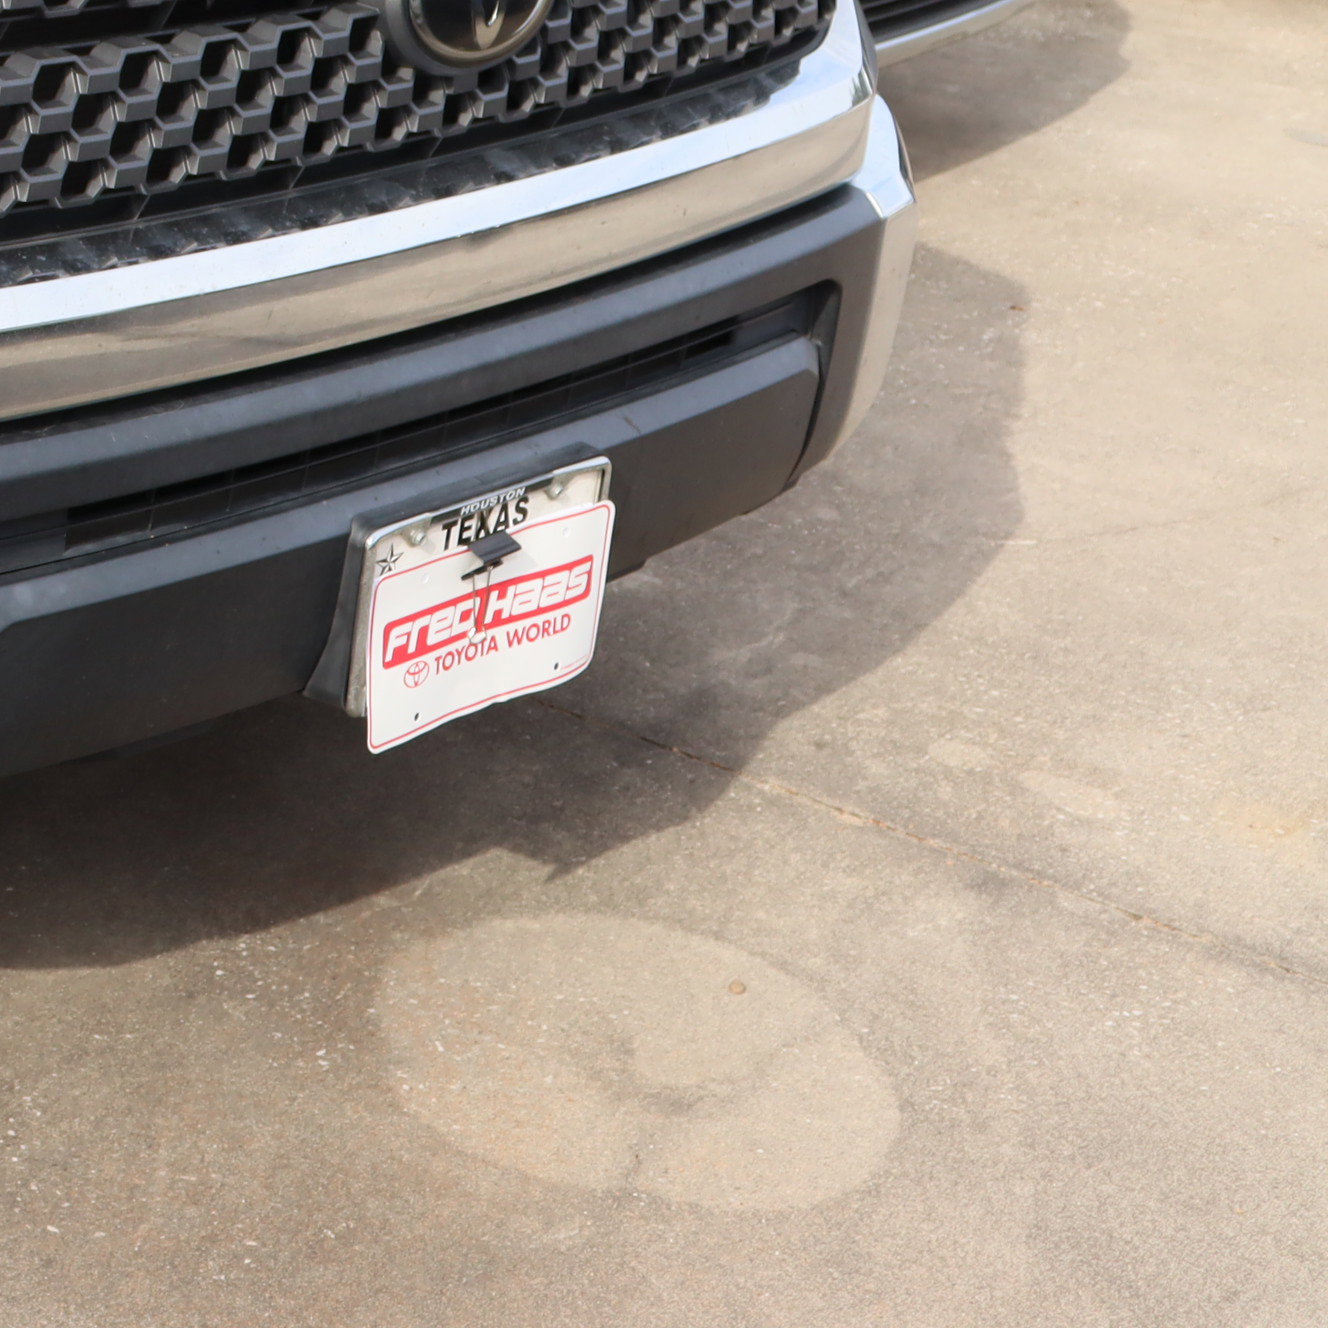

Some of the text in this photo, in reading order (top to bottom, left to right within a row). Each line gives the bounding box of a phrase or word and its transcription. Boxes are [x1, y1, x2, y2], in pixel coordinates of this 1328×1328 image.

[442, 496, 530, 551] TEXAS
[460, 487, 526, 516] HOUSTON
[434, 612, 572, 674] TOYOTA WORLD
